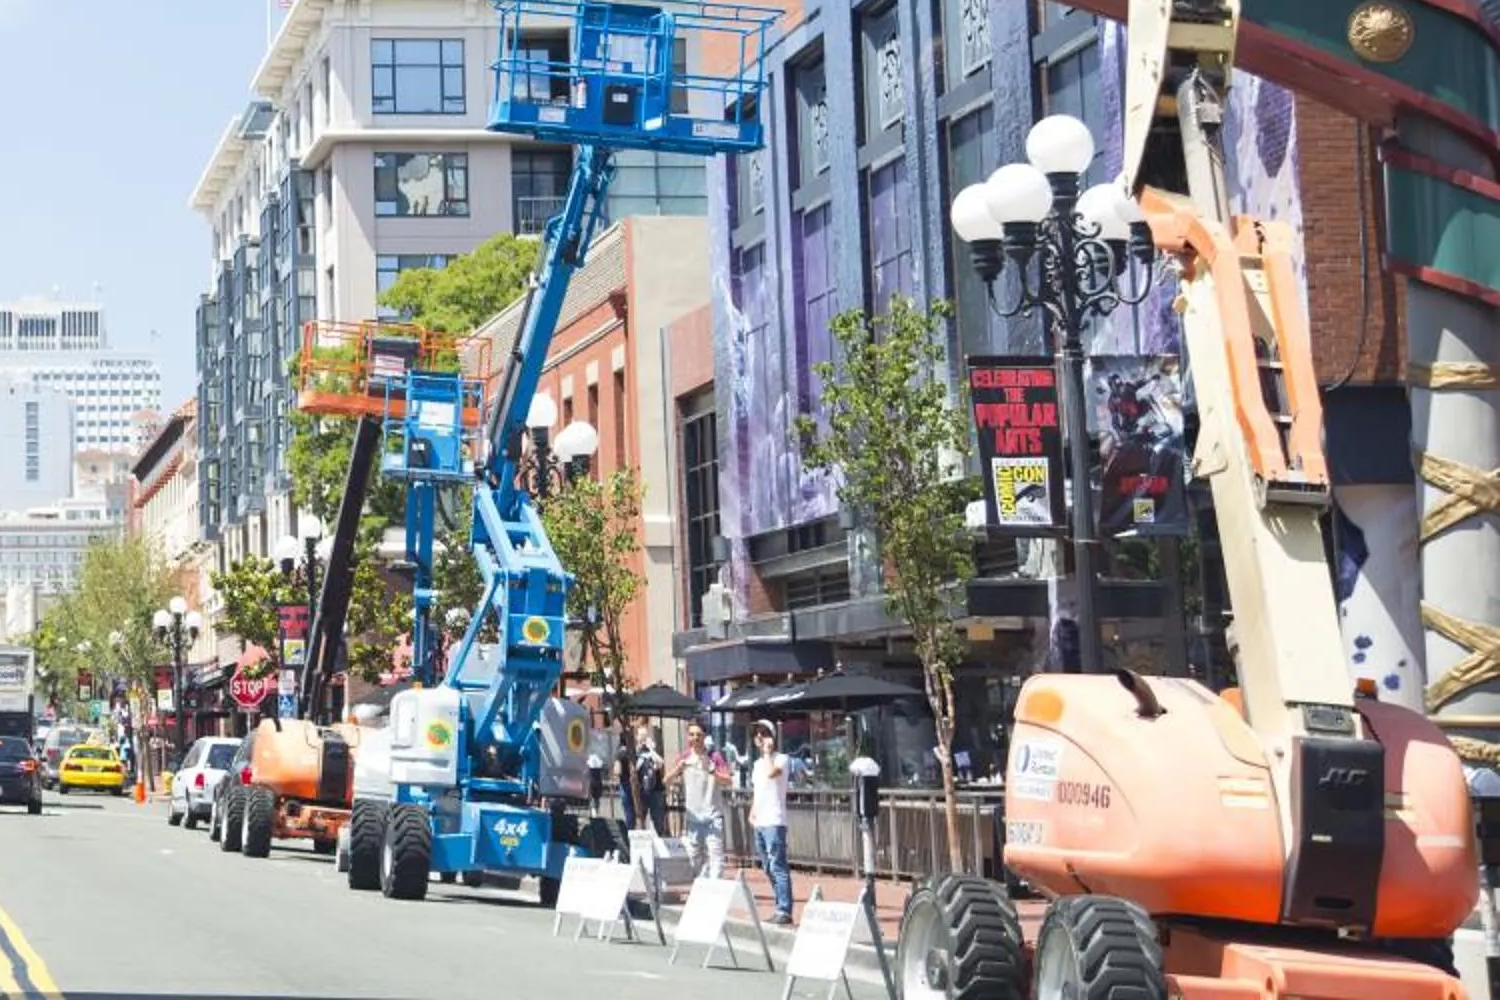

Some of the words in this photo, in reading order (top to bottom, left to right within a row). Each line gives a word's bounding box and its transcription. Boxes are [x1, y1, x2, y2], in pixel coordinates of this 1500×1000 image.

[975, 403, 1057, 427] POPULAR
[995, 427, 1043, 456] ARTS
[1013, 465, 1046, 483] CON
[233, 679, 263, 696] STOP
[493, 818, 528, 837] 4x4
